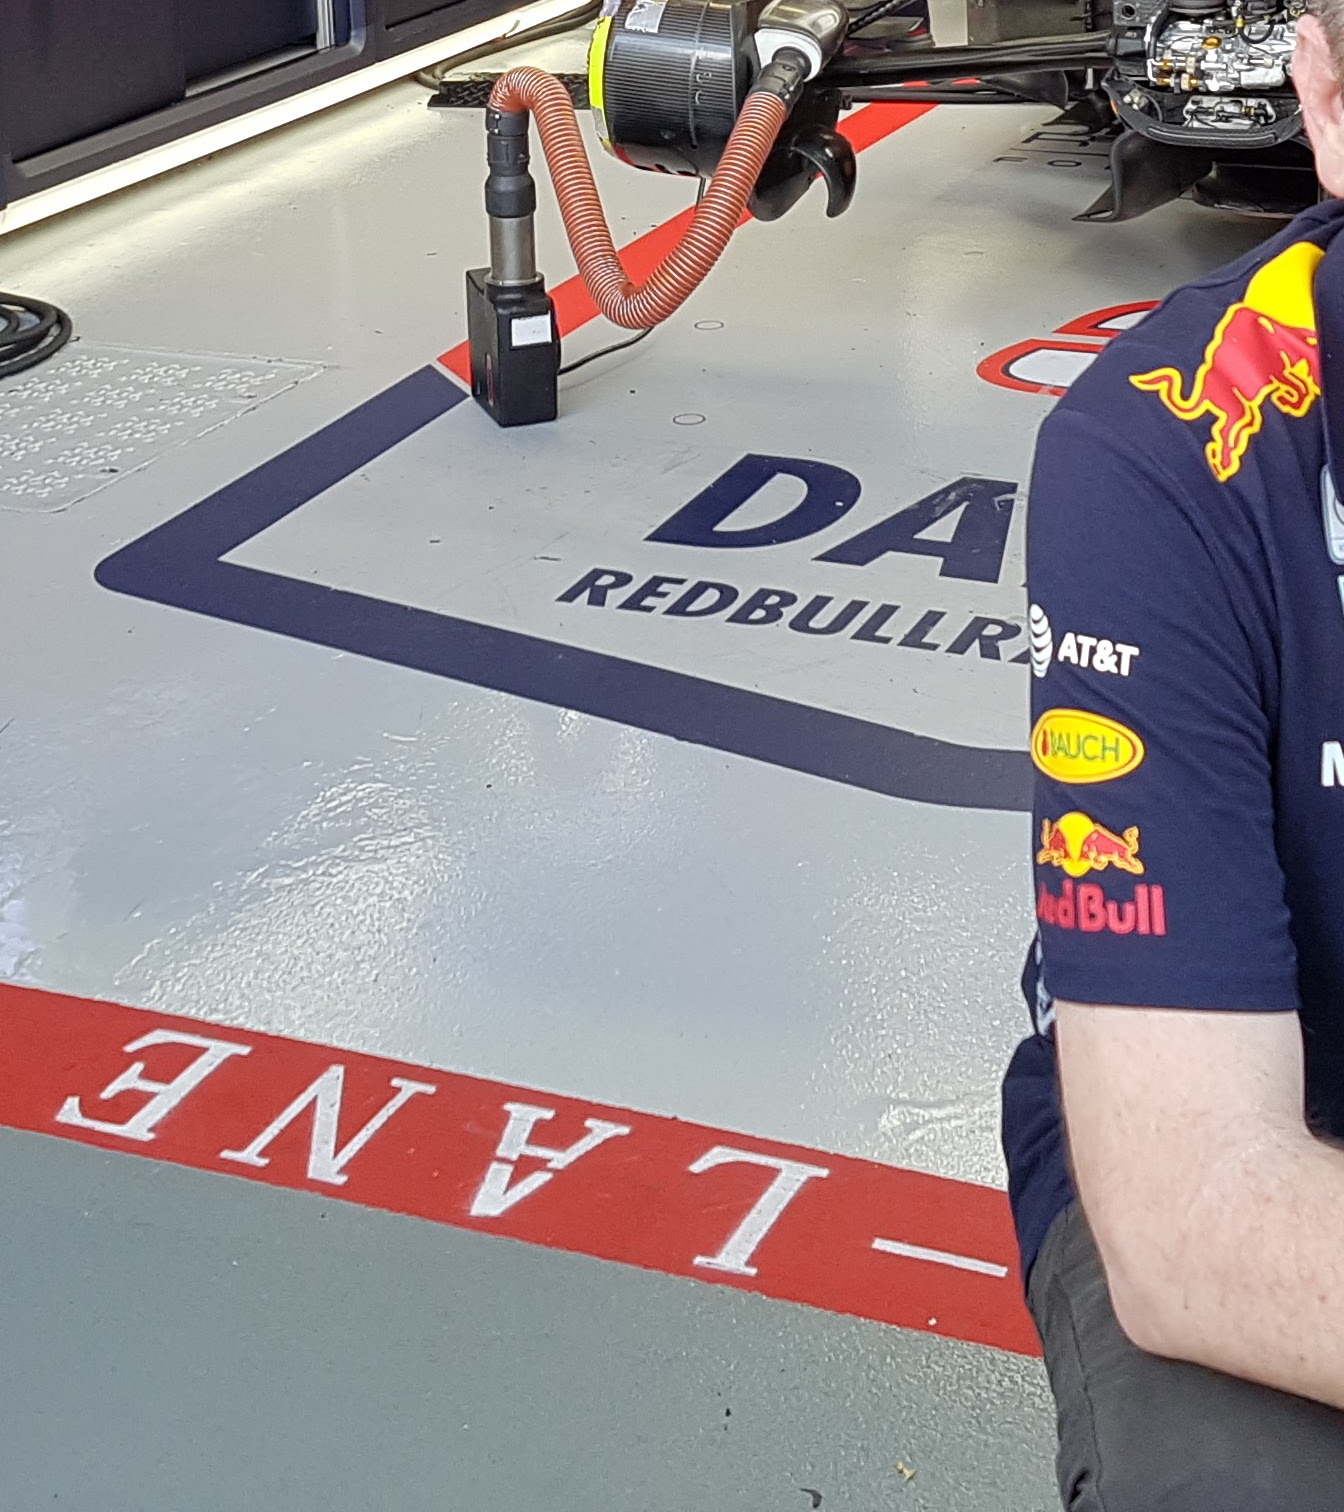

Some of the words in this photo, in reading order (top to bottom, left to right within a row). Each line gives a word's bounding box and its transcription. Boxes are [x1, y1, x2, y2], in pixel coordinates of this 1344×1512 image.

[643, 453, 1028, 587] DA
[1057, 632, 1140, 676] AT&T
[55, 1029, 829, 1276] LANE
